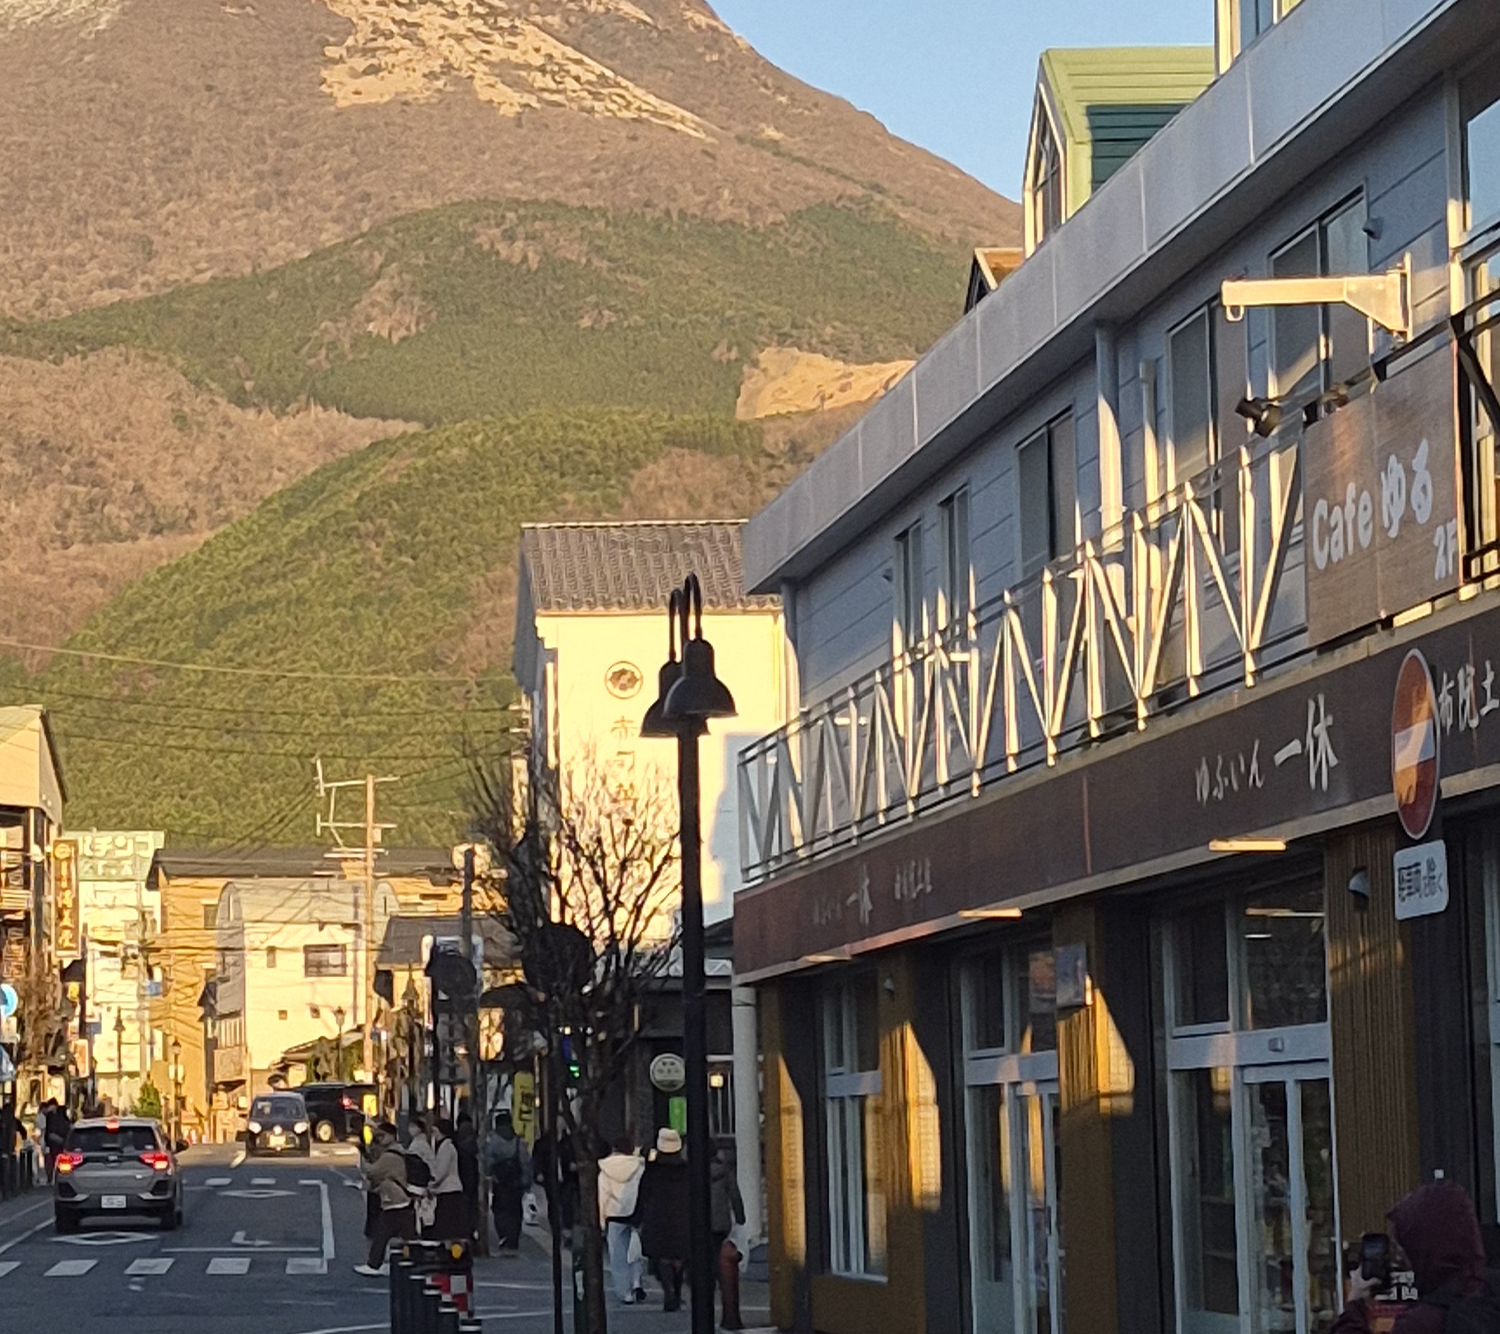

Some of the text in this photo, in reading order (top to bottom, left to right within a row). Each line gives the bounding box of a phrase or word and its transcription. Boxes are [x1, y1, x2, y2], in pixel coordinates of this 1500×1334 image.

[1312, 437, 1433, 570] Cafe ゆる
[1433, 518, 1457, 581] 2F
